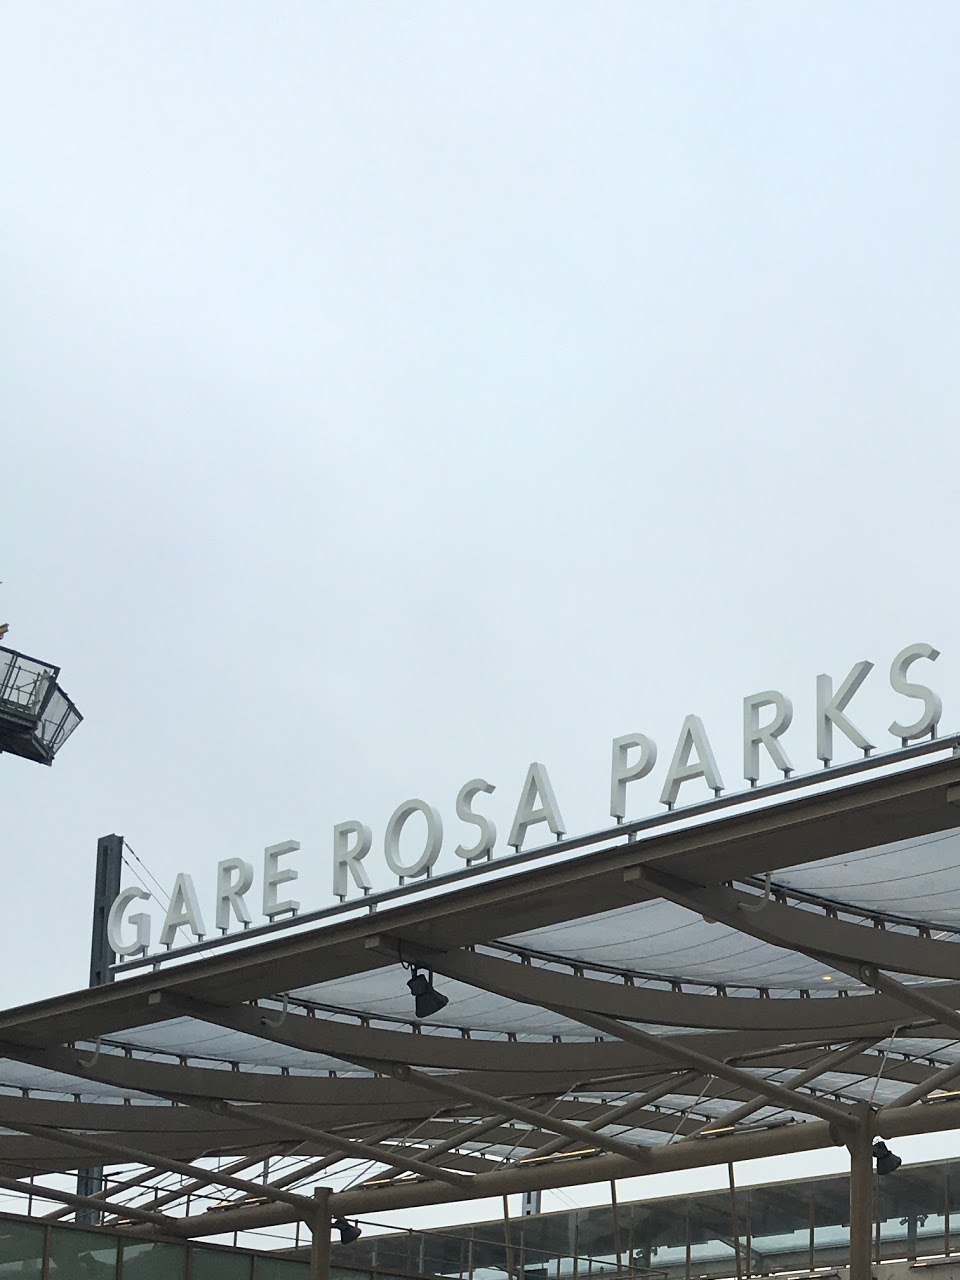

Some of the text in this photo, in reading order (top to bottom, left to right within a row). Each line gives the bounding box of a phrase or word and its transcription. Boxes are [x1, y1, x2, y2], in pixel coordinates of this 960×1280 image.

[107, 642, 942, 957] GARE ROSA PARKS
